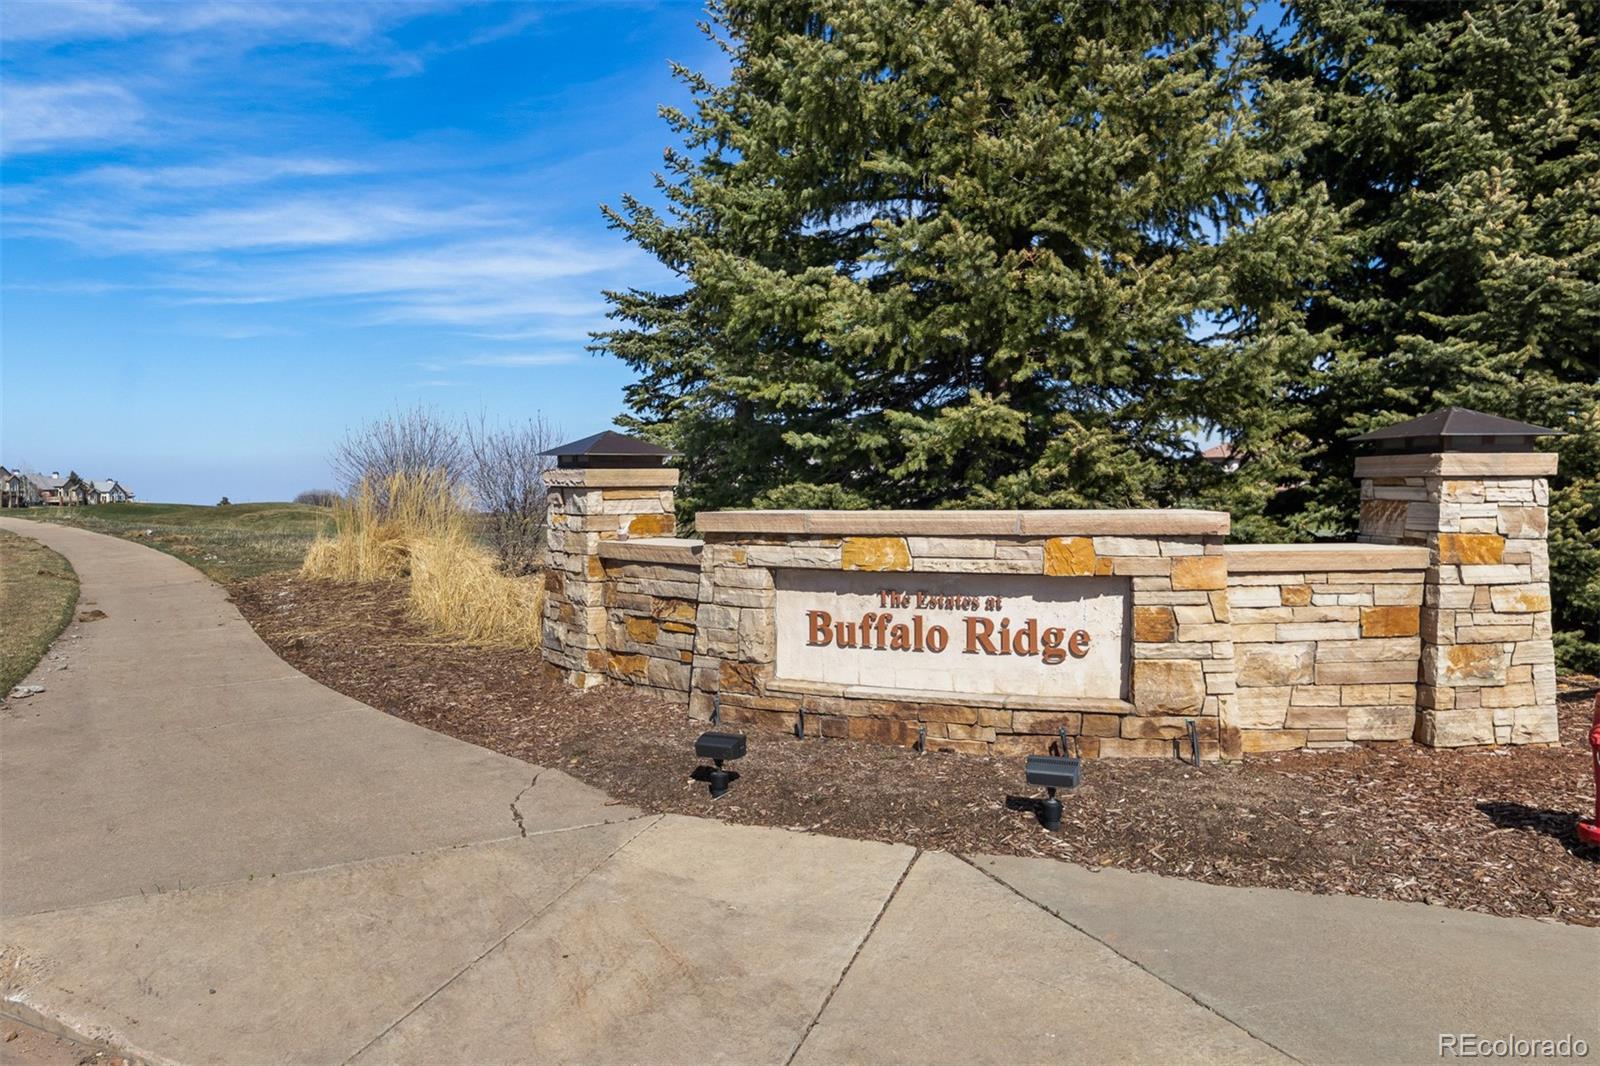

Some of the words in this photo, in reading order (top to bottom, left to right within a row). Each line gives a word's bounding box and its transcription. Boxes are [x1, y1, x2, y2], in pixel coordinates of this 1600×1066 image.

[879, 590, 910, 609] The
[915, 591, 980, 611] Estates
[984, 594, 1003, 612] at
[806, 610, 949, 652] Buffalo
[962, 615, 1091, 664] Ridge
